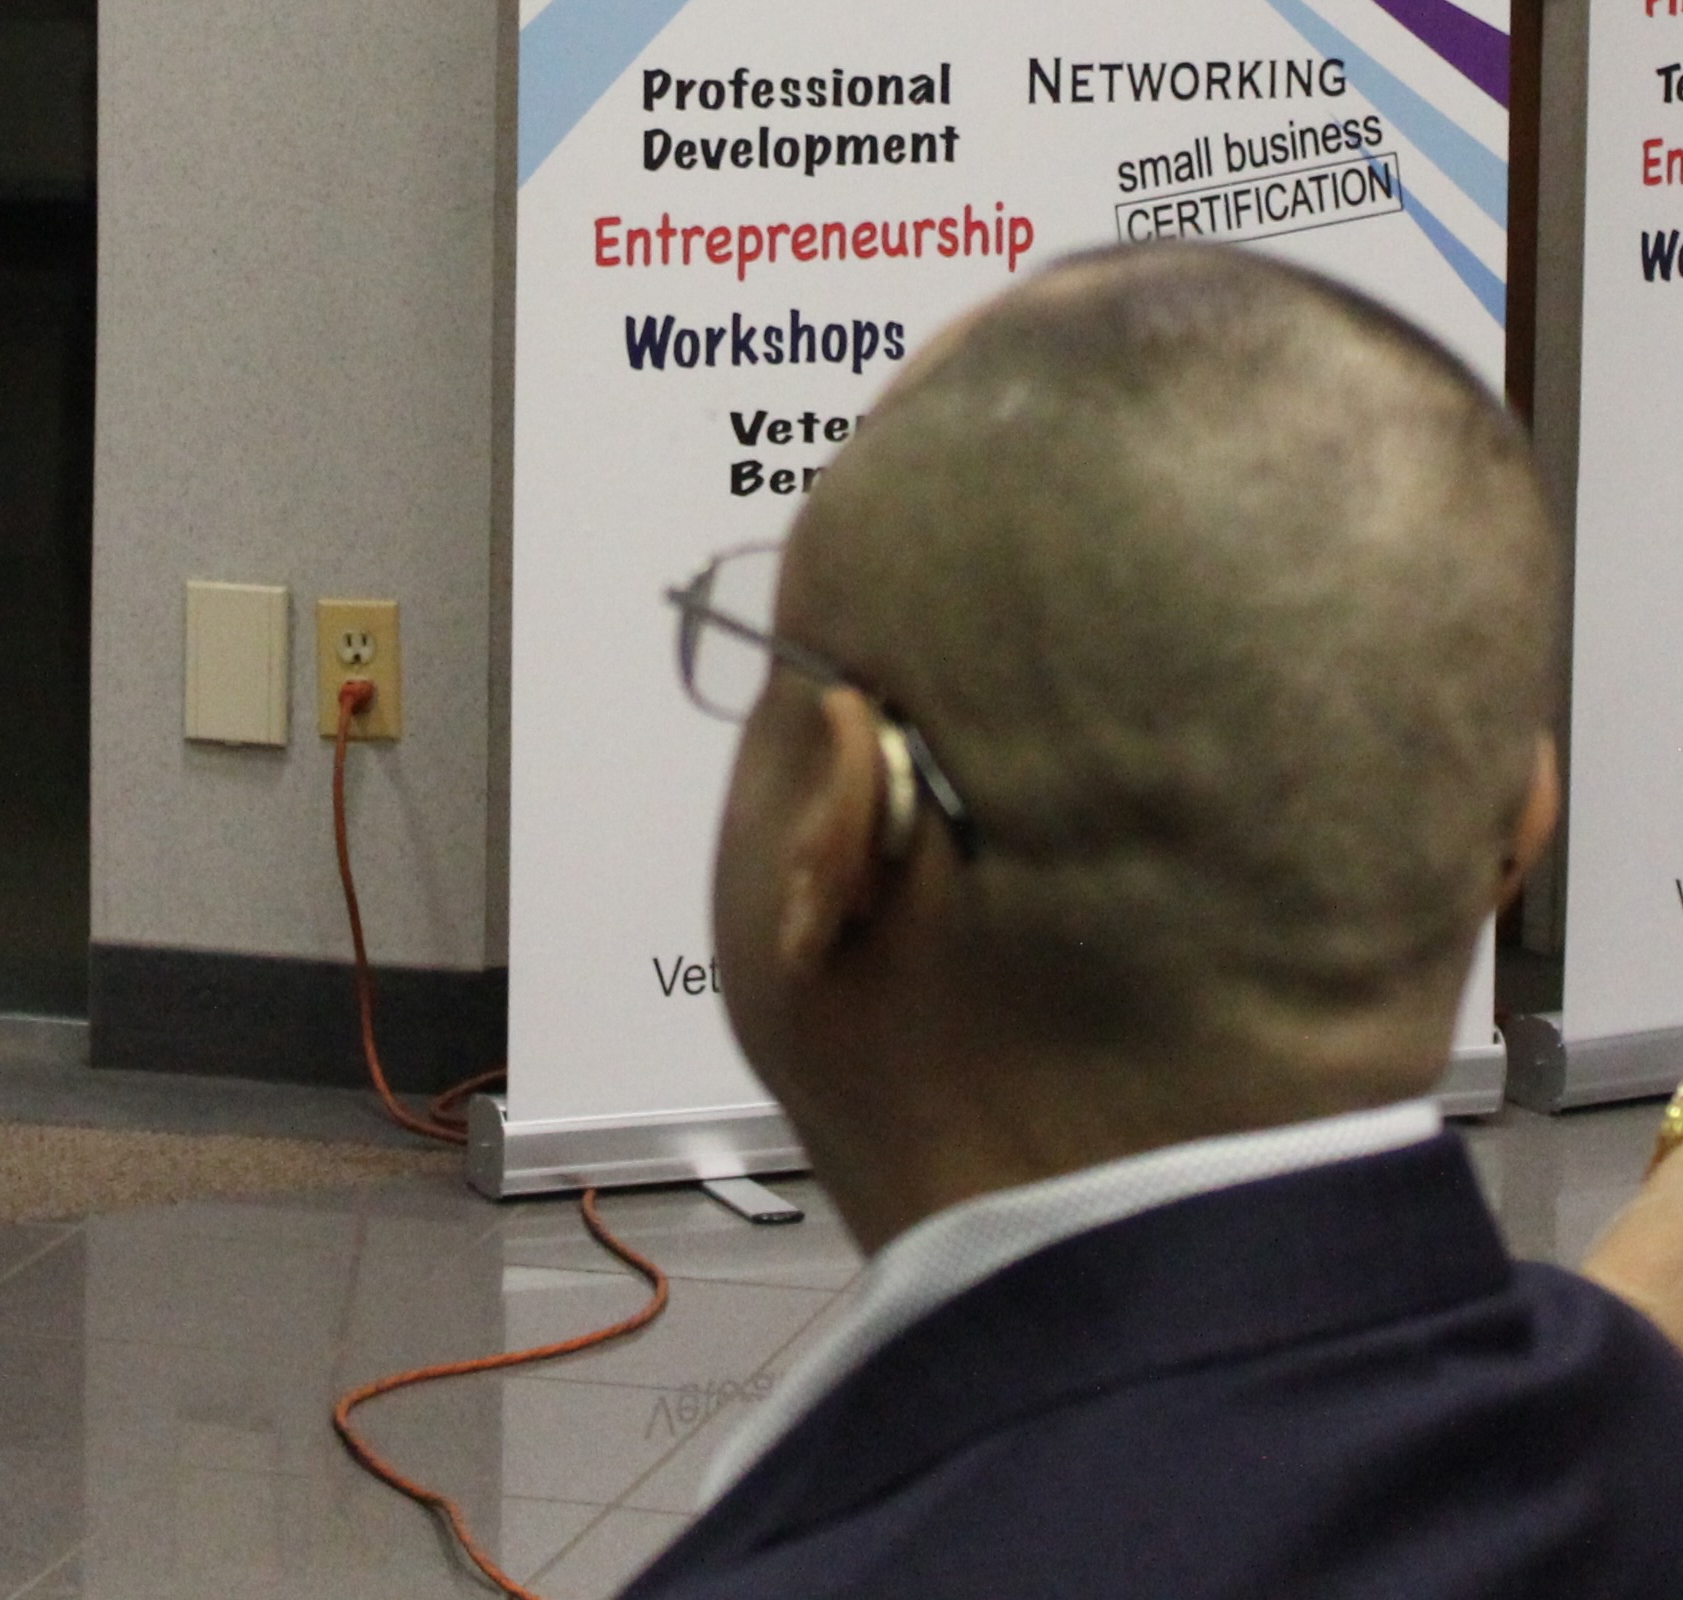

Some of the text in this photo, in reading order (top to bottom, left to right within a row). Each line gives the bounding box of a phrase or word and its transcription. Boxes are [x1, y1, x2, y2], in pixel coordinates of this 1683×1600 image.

[642, 63, 952, 110] Professional
[1027, 56, 1348, 105] NETWORKING
[642, 125, 960, 177] Development
[1118, 115, 1383, 193] small business
[1127, 162, 1393, 241] CERTIFICATION
[594, 201, 1035, 280] Entrepreneurship
[625, 309, 906, 373] Workshops
